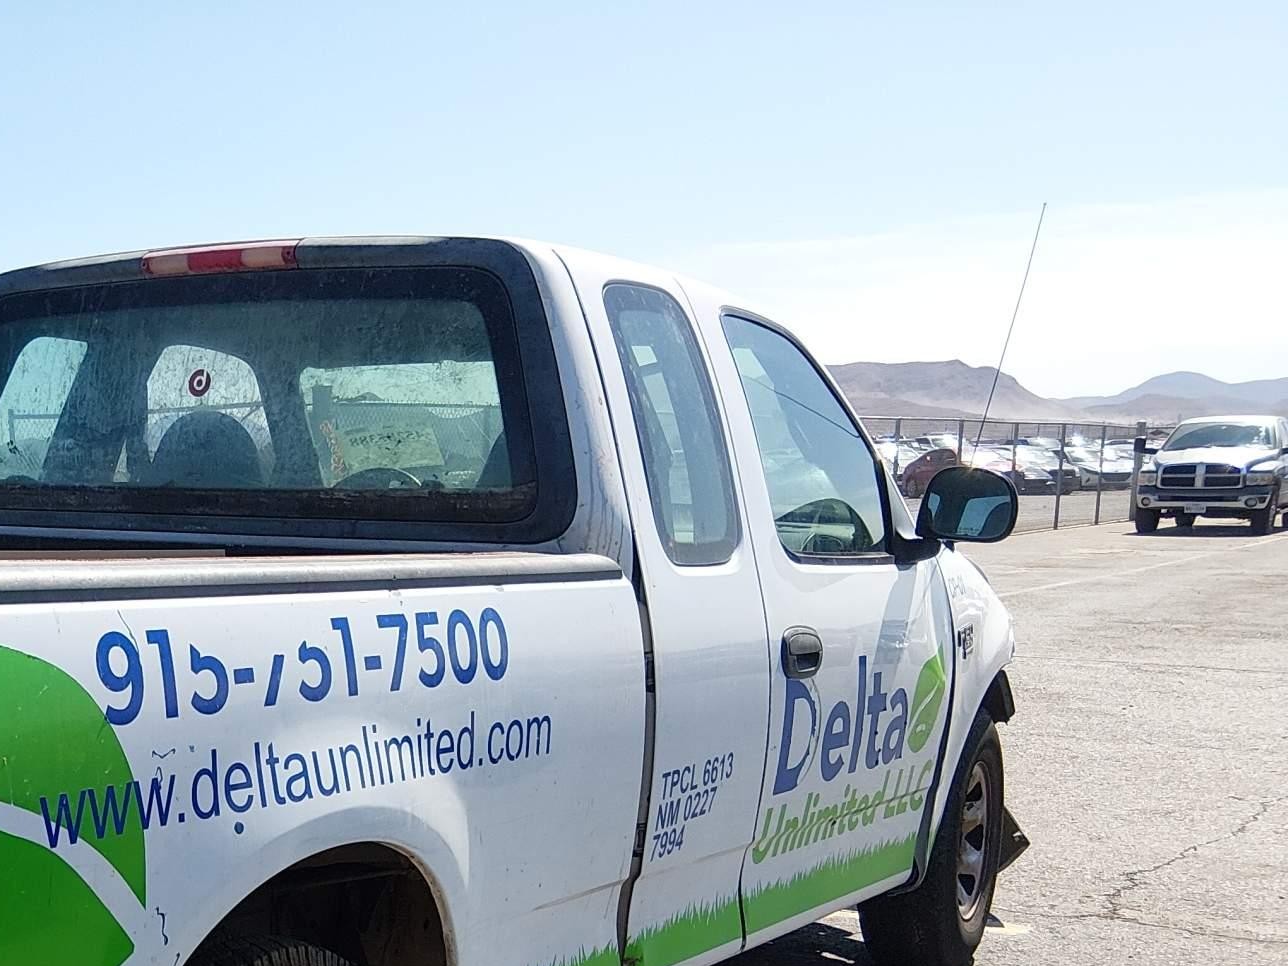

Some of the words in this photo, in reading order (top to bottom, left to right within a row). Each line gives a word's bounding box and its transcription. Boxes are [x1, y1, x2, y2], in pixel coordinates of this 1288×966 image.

[773, 655, 908, 796] Delta
[40, 711, 552, 849] www.deltaunlimited.com
[655, 798, 681, 832] NM
[683, 786, 717, 821] 0227
[662, 764, 698, 800] TPCL
[702, 752, 734, 784] 6613
[752, 769, 890, 864] Unlimited
[883, 759, 933, 819] LLC
[650, 824, 685, 862] 7994
